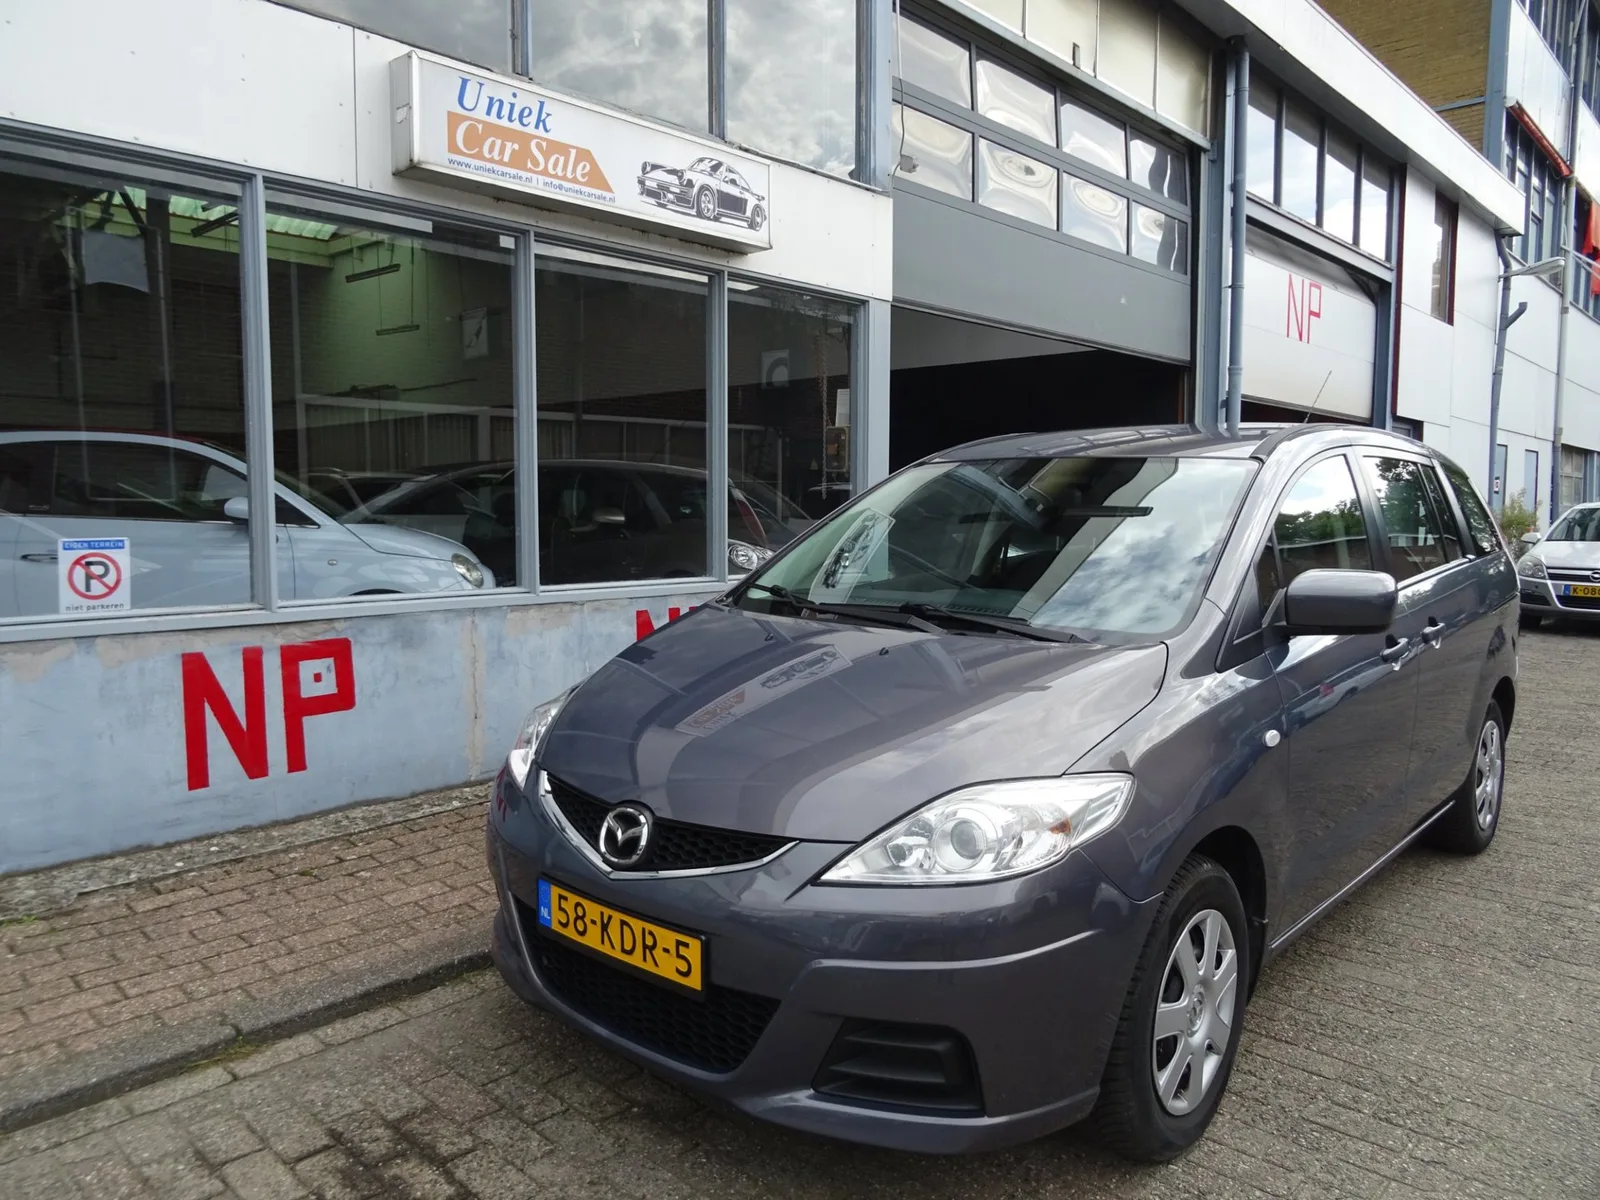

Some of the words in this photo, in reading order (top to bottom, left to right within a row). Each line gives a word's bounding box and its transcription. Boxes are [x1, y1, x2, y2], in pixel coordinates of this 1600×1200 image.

[457, 76, 553, 133] Uniek
[456, 120, 520, 163] Car
[527, 138, 591, 182] Sale
[447, 157, 533, 184] www.uniekcarsale.nl
[543, 179, 616, 204] info@uniekcarsale.nl
[1286, 273, 1322, 344] NP
[64, 541, 88, 549] EIGEN
[90, 540, 124, 548] TERREIN
[86, 602, 124, 611] parkeren
[181, 637, 356, 792] NP
[540, 906, 551, 920] NL
[558, 893, 692, 978] 58-KDR-5
